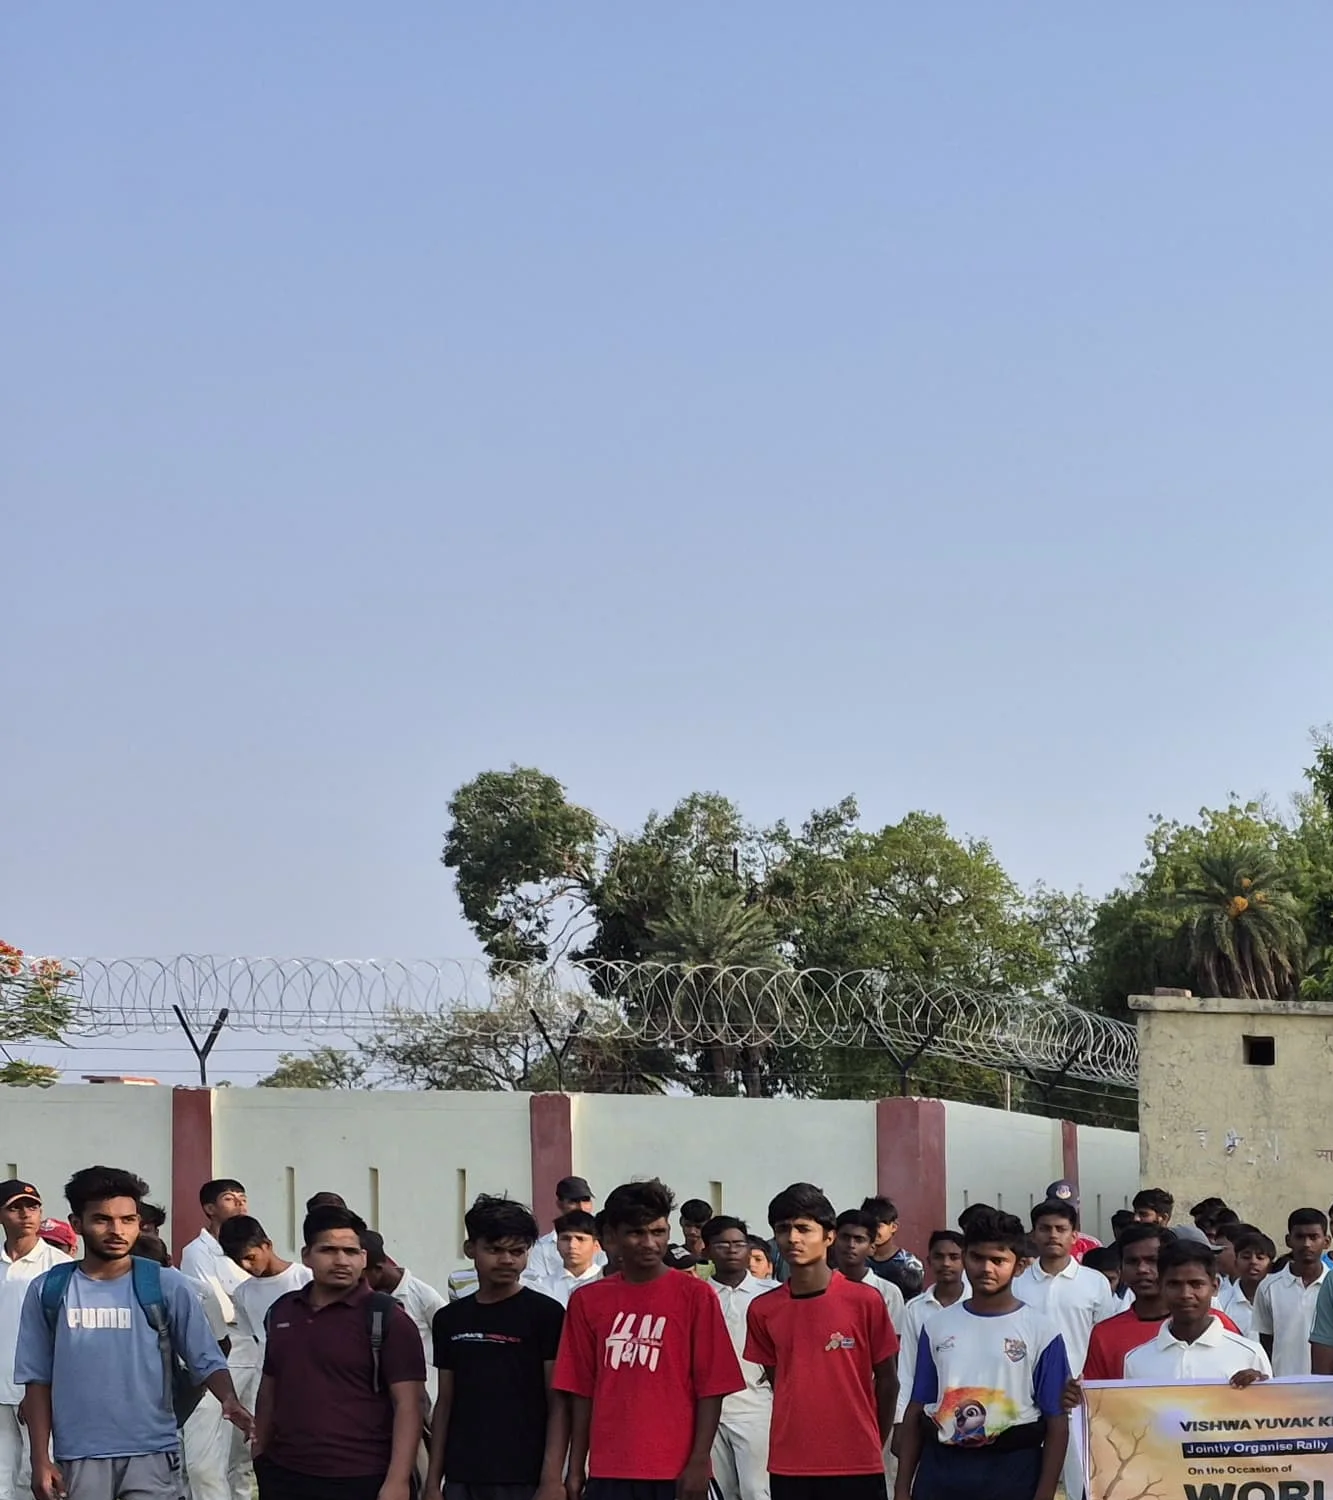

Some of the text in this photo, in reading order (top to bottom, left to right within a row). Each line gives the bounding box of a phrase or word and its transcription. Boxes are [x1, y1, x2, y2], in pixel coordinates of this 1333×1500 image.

[68, 1308, 131, 1328] PUMA
[604, 1311, 666, 1372] H&M
[1180, 1419, 1251, 1432] VISHWA
[1254, 1417, 1314, 1429] YUVAK
[1187, 1440, 1328, 1455] Jointly Organise Rally
[1188, 1464, 1292, 1476] On the Occasion of
